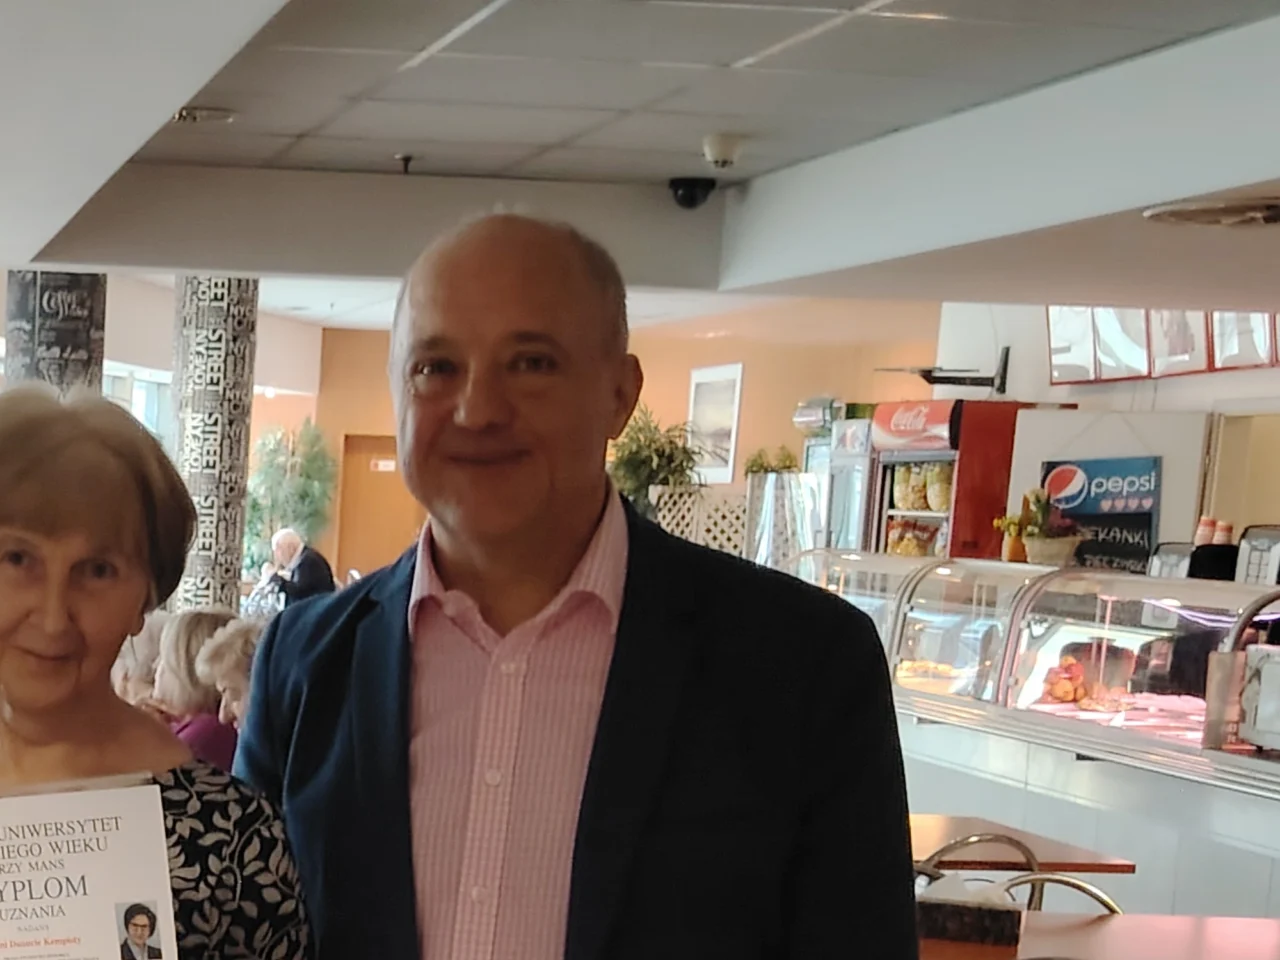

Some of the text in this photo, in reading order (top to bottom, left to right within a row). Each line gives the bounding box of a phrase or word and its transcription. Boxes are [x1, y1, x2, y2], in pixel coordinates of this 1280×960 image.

[206, 328, 227, 396] STREET
[202, 412, 222, 479] STREET
[1090, 471, 1156, 498] pepsi
[198, 494, 218, 561] STREET
[28, 859, 65, 872] MANS
[49, 836, 109, 855] WIEKU
